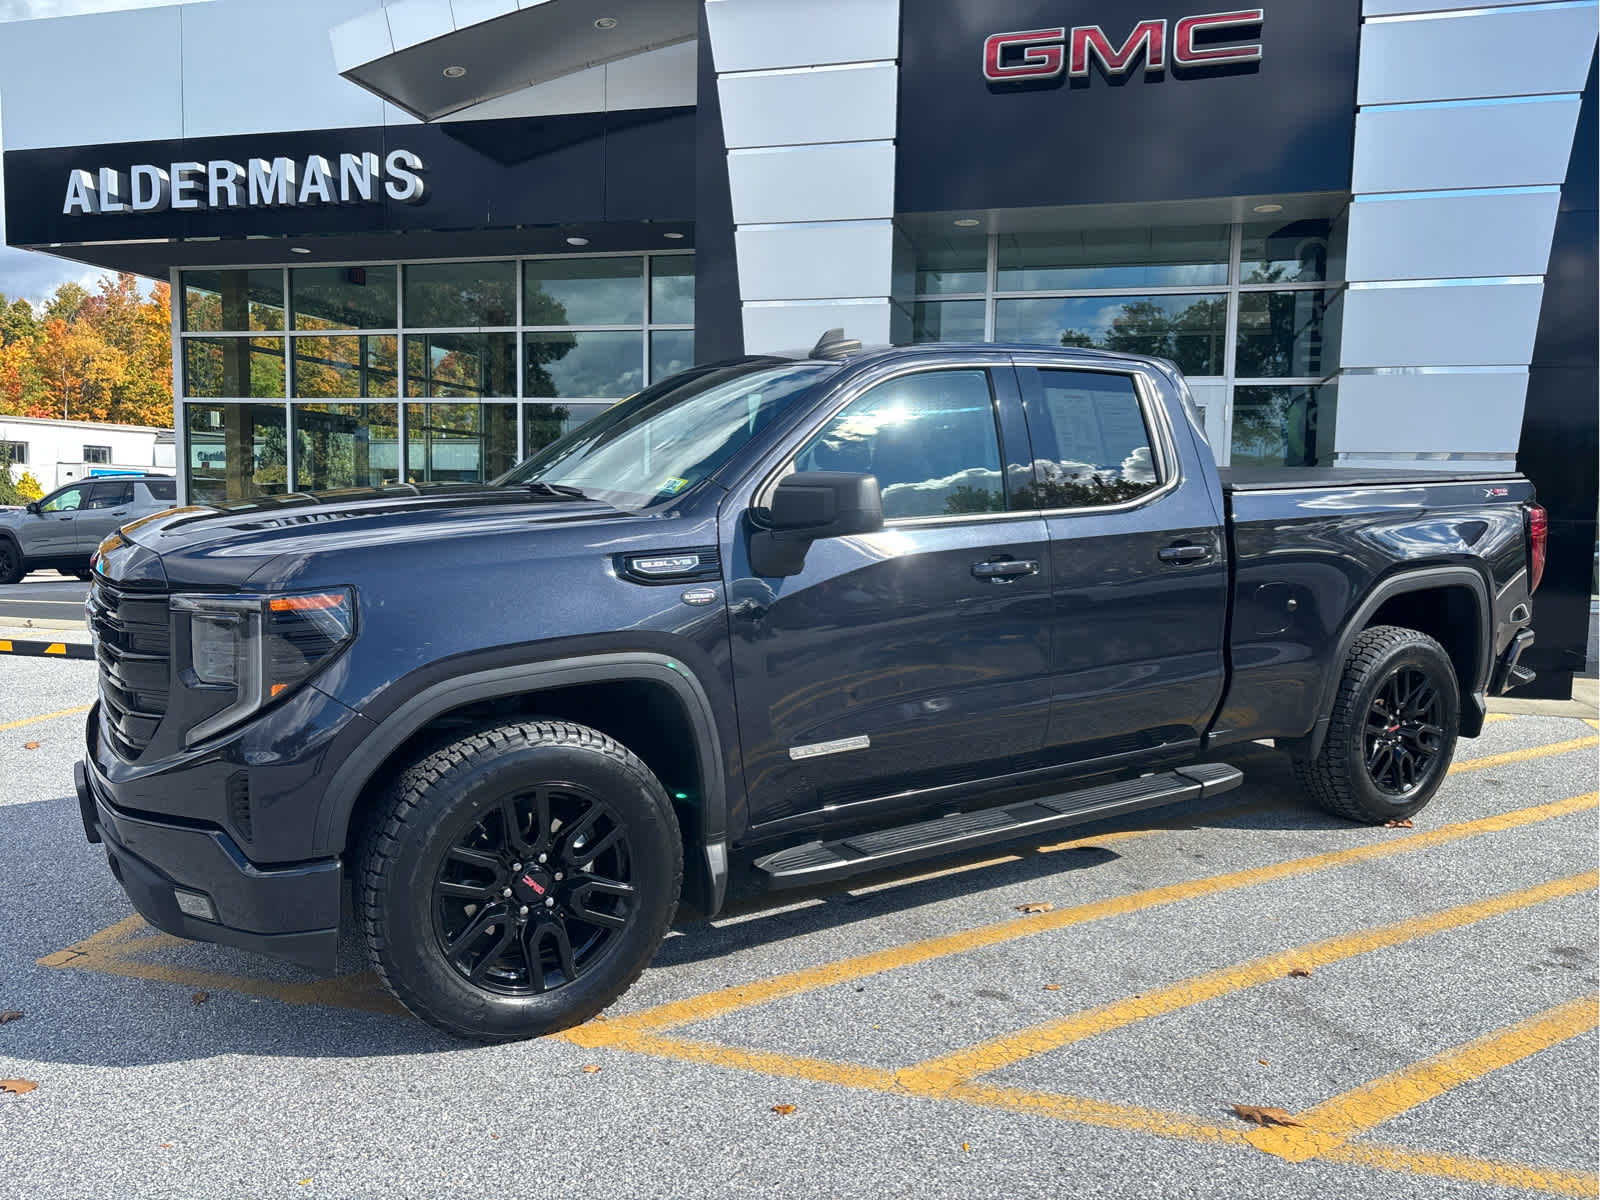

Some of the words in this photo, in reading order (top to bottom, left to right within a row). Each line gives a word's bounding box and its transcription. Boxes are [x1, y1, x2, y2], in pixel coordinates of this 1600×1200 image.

[983, 8, 1264, 82] GMC
[63, 149, 424, 214] ALDERMANS
[522, 874, 545, 895] GMC
